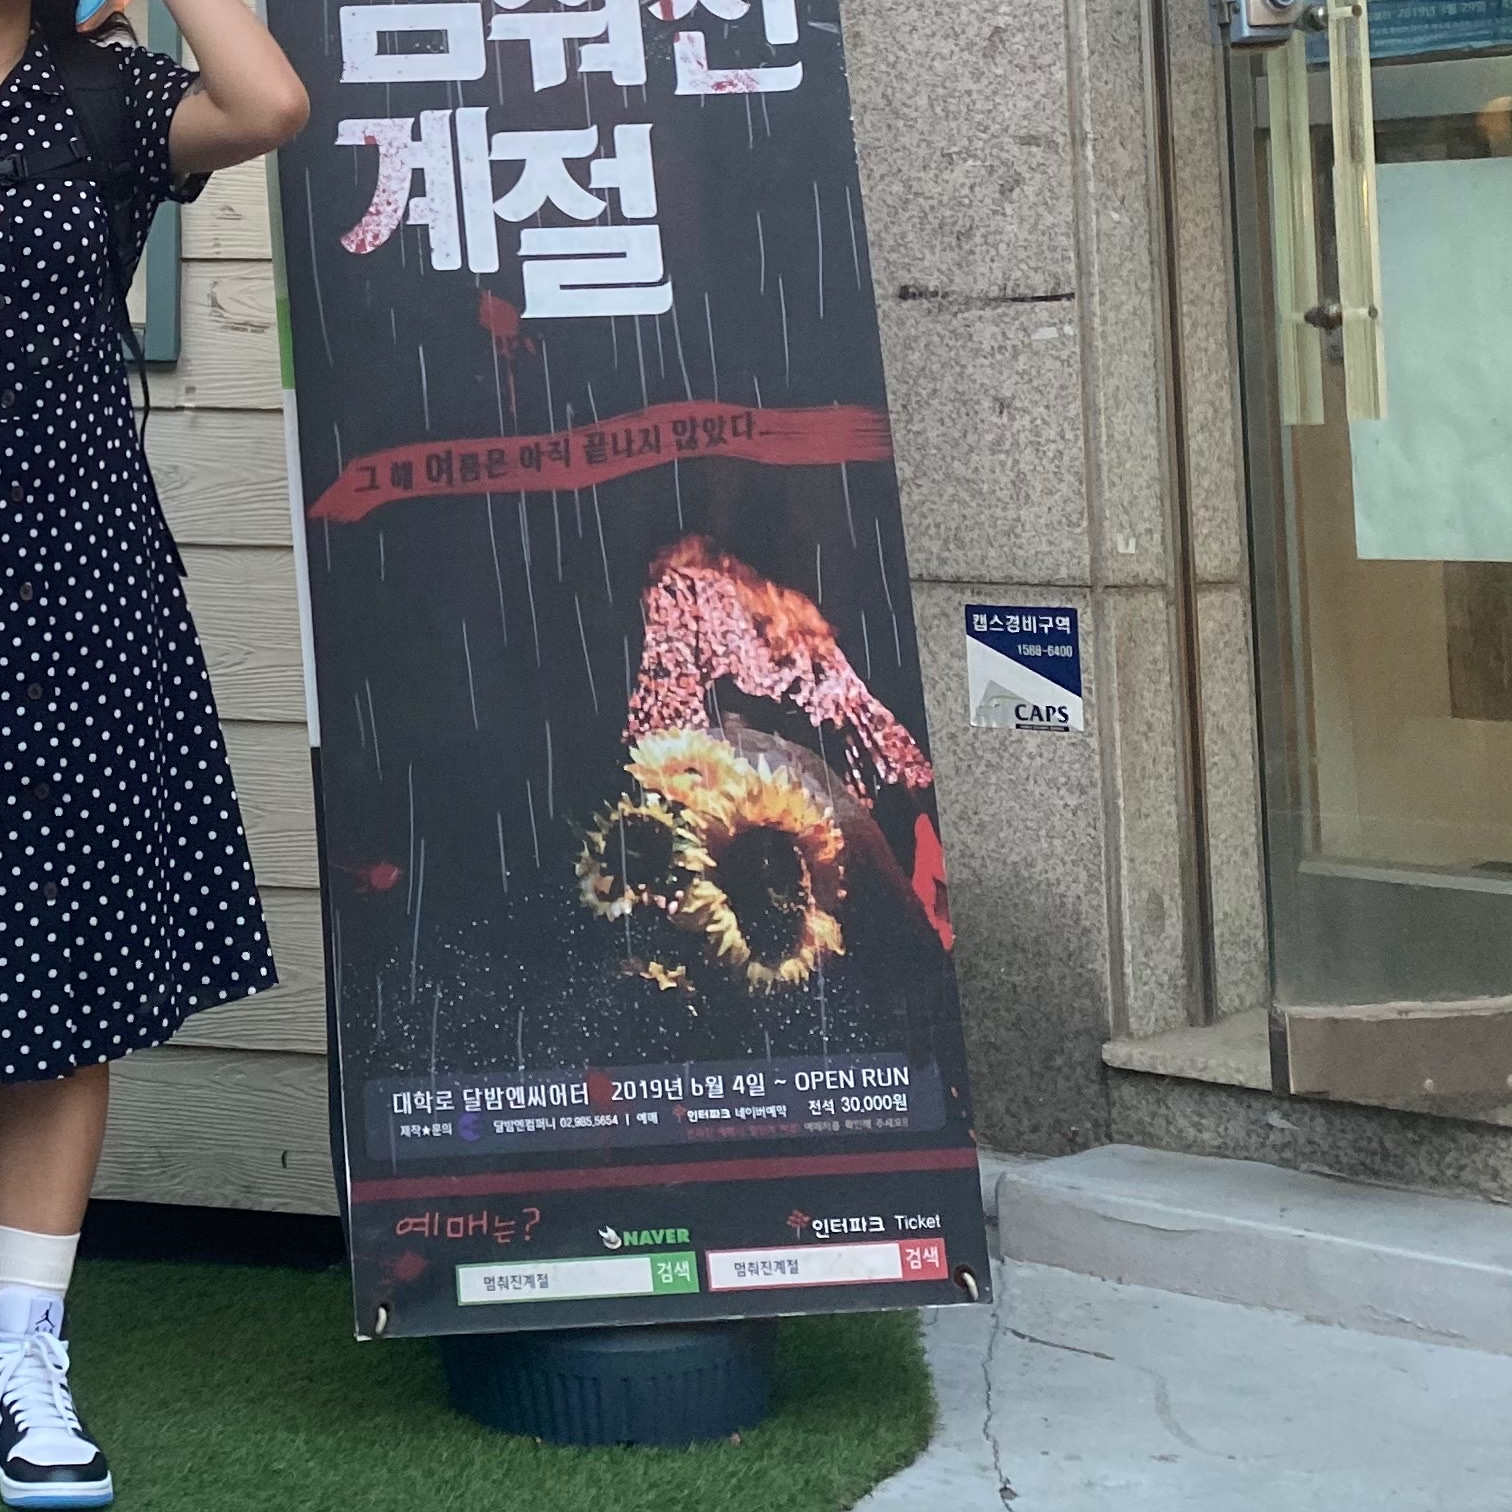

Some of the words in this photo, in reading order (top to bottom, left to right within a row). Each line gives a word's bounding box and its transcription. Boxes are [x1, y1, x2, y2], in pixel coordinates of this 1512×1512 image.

[334, 107, 673, 319] 계절
[426, 450, 507, 485] 여름은
[520, 439, 571, 472] 아직
[584, 424, 661, 464] 끝나지
[972, 614, 1071, 634] 캡스경비구역
[1017, 644, 1073, 658] 1588-6400
[1014, 704, 1070, 723] CAPS
[392, 1090, 455, 1115] 대학로
[463, 1082, 589, 1112] 달밤엔씨어터
[611, 1078, 684, 1101] 2019년
[732, 1072, 766, 1098] 4일
[795, 1070, 855, 1092] OPEN
[862, 1066, 910, 1088] RUN
[636, 1112, 659, 1125] 예매
[687, 1106, 731, 1123] 인터파크
[808, 1098, 835, 1116] 전석
[622, 1228, 691, 1247] NAVER
[811, 1216, 886, 1239] 인터파크
[894, 1214, 942, 1231] Ticket
[734, 1259, 800, 1277] 멈춰진계절
[905, 1246, 939, 1270] 검색
[483, 1273, 549, 1291] 멈춰진계절
[656, 1260, 691, 1284] 검색
